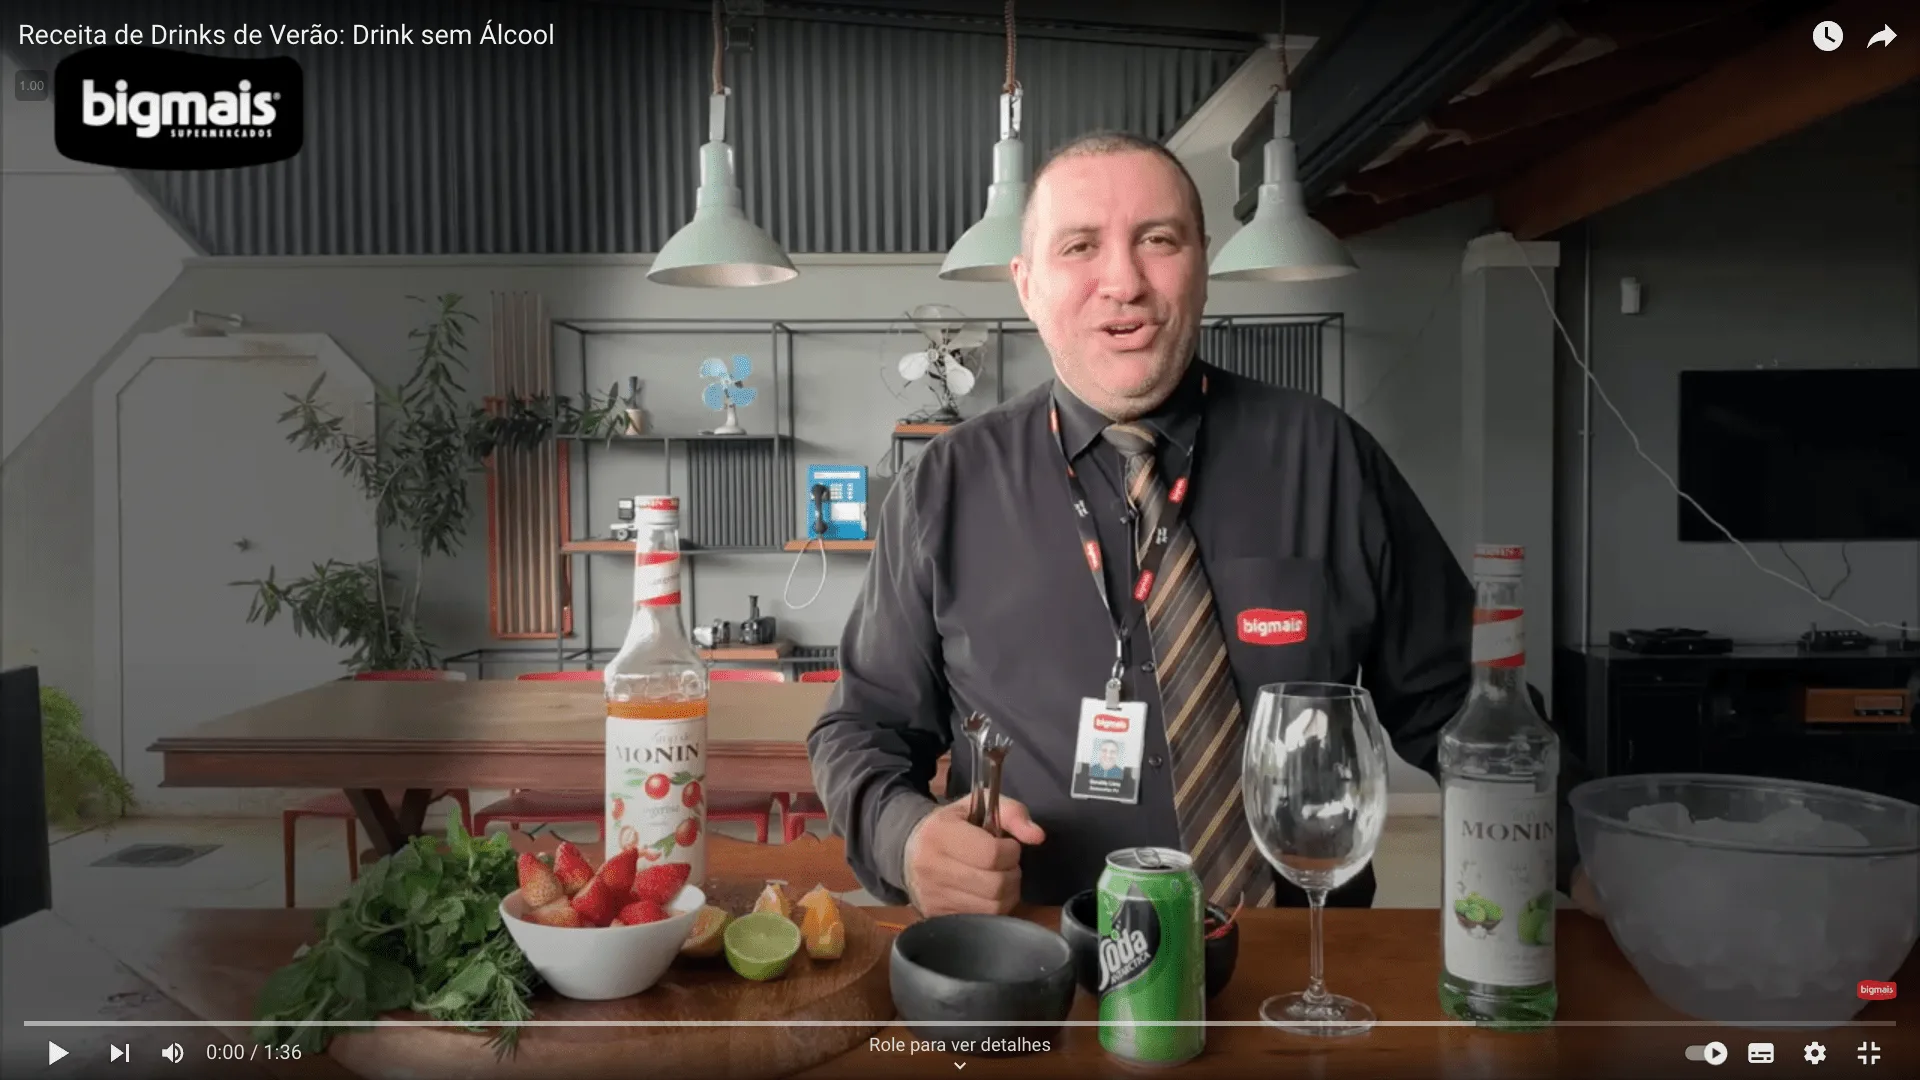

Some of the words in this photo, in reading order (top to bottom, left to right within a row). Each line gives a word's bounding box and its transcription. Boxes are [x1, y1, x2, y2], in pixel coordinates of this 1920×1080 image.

[1242, 617, 1303, 638] bigmais
[616, 742, 700, 764] MONIN
[1461, 819, 1555, 842] MONIN
[1110, 951, 1152, 985] ANTARCTICA
